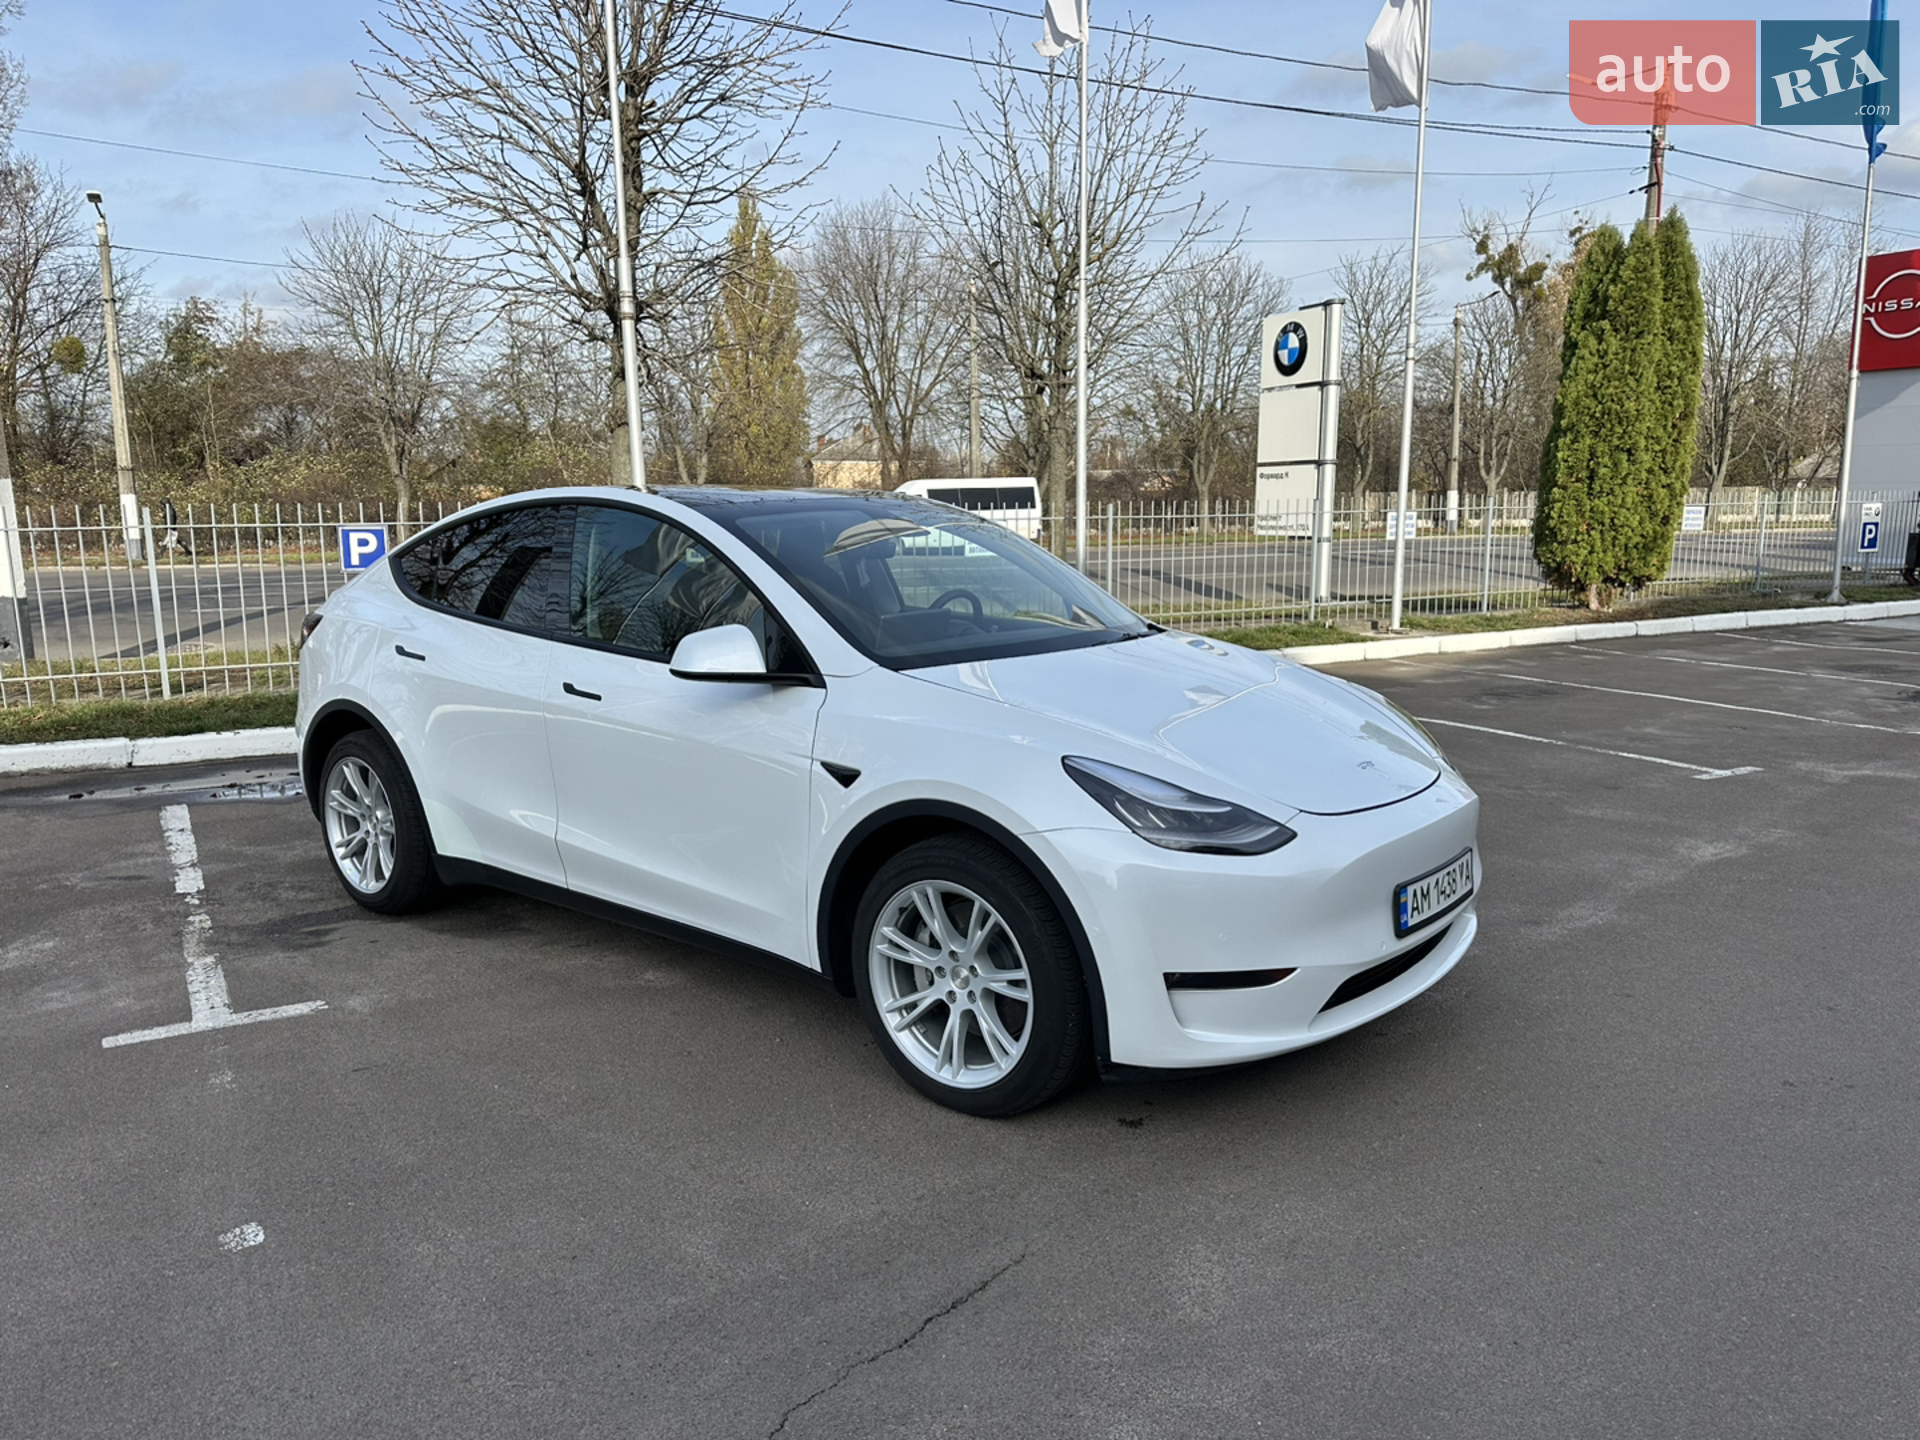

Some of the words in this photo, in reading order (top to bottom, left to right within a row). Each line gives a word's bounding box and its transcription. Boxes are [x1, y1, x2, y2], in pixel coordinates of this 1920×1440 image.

[349, 532, 378, 566] P
[1864, 524, 1876, 547] P
[1410, 882, 1431, 919] AM
[1433, 867, 1457, 905] 1438
